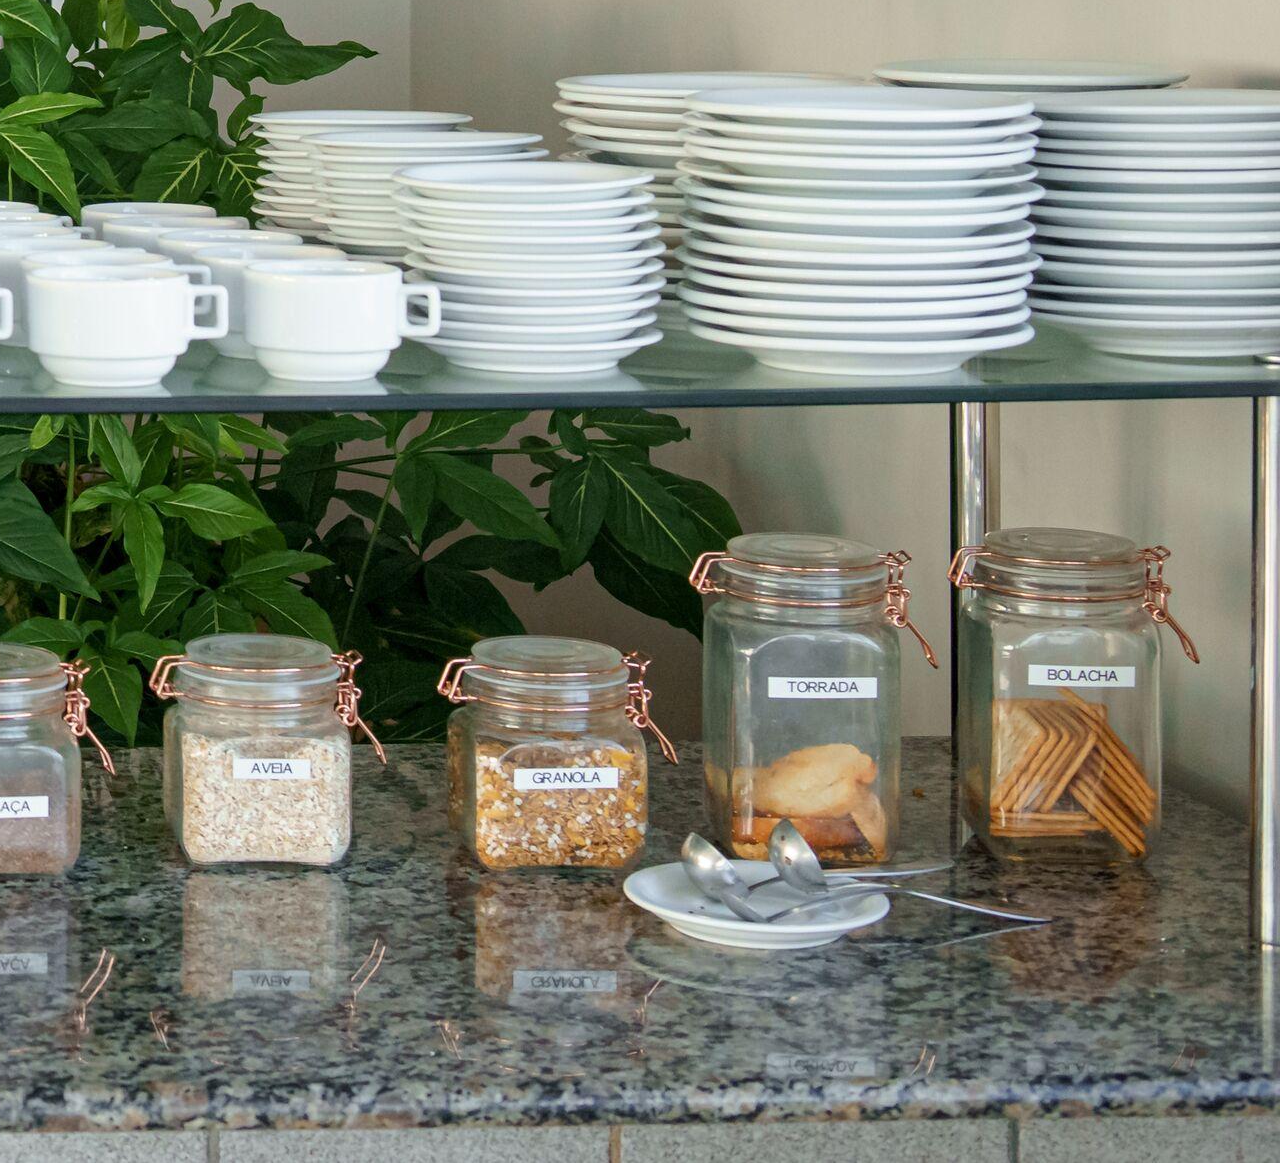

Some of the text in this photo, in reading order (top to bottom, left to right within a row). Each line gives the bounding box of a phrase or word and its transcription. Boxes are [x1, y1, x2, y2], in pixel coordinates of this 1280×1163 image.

[1047, 668, 1118, 682] BOLACHA
[787, 681, 859, 693] TORRADA
[251, 763, 293, 774] AVEIA
[532, 771, 601, 784] GRANOLA
